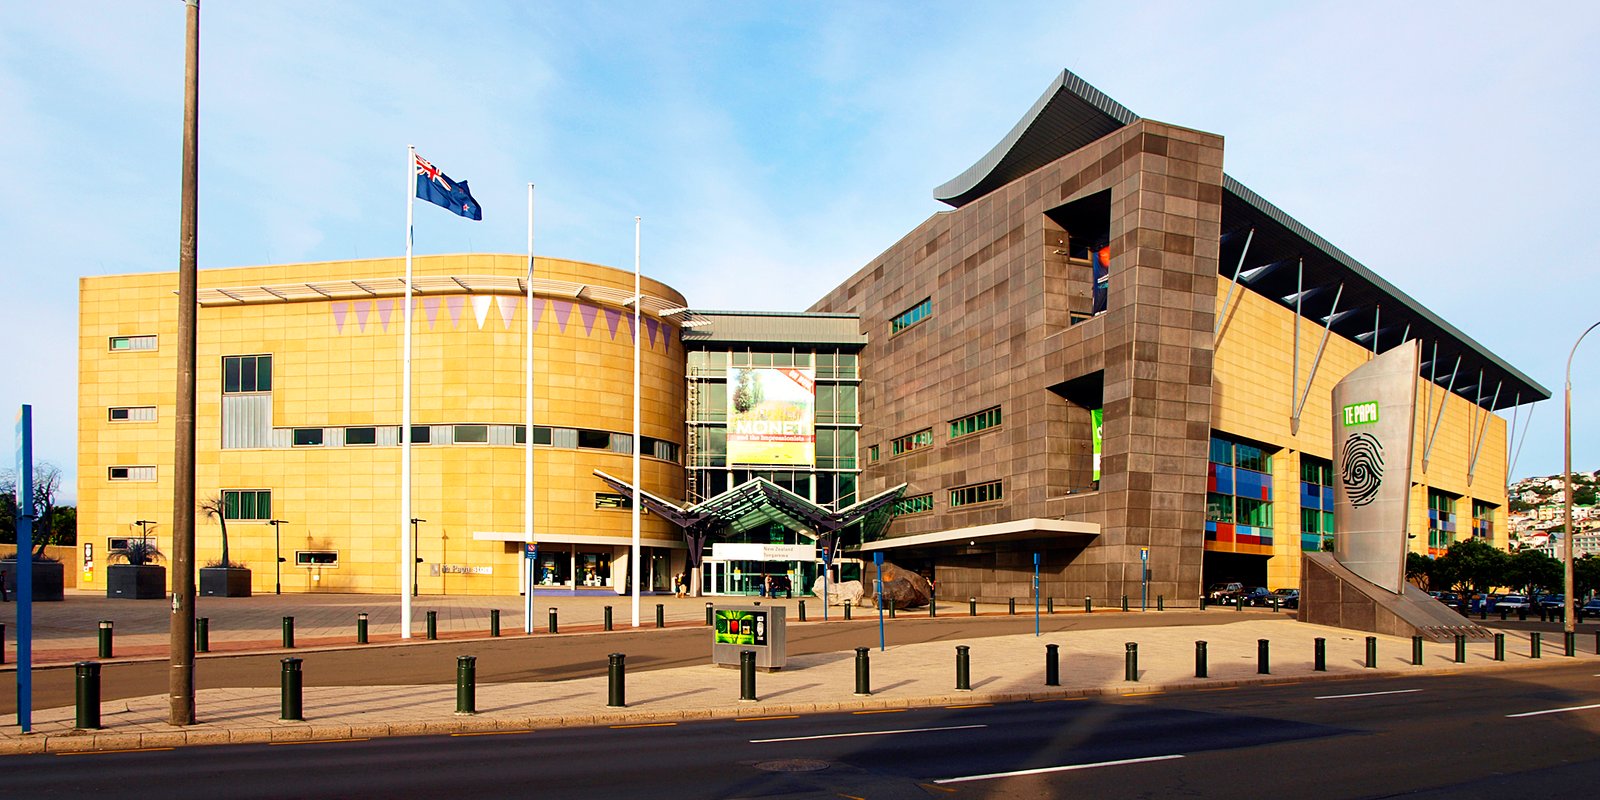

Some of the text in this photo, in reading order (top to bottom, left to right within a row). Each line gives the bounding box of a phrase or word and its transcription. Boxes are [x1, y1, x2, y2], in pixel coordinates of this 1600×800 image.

[1344, 403, 1377, 425] TE PAPA
[736, 420, 805, 435] MONET
[760, 434, 805, 442] Impressionists
